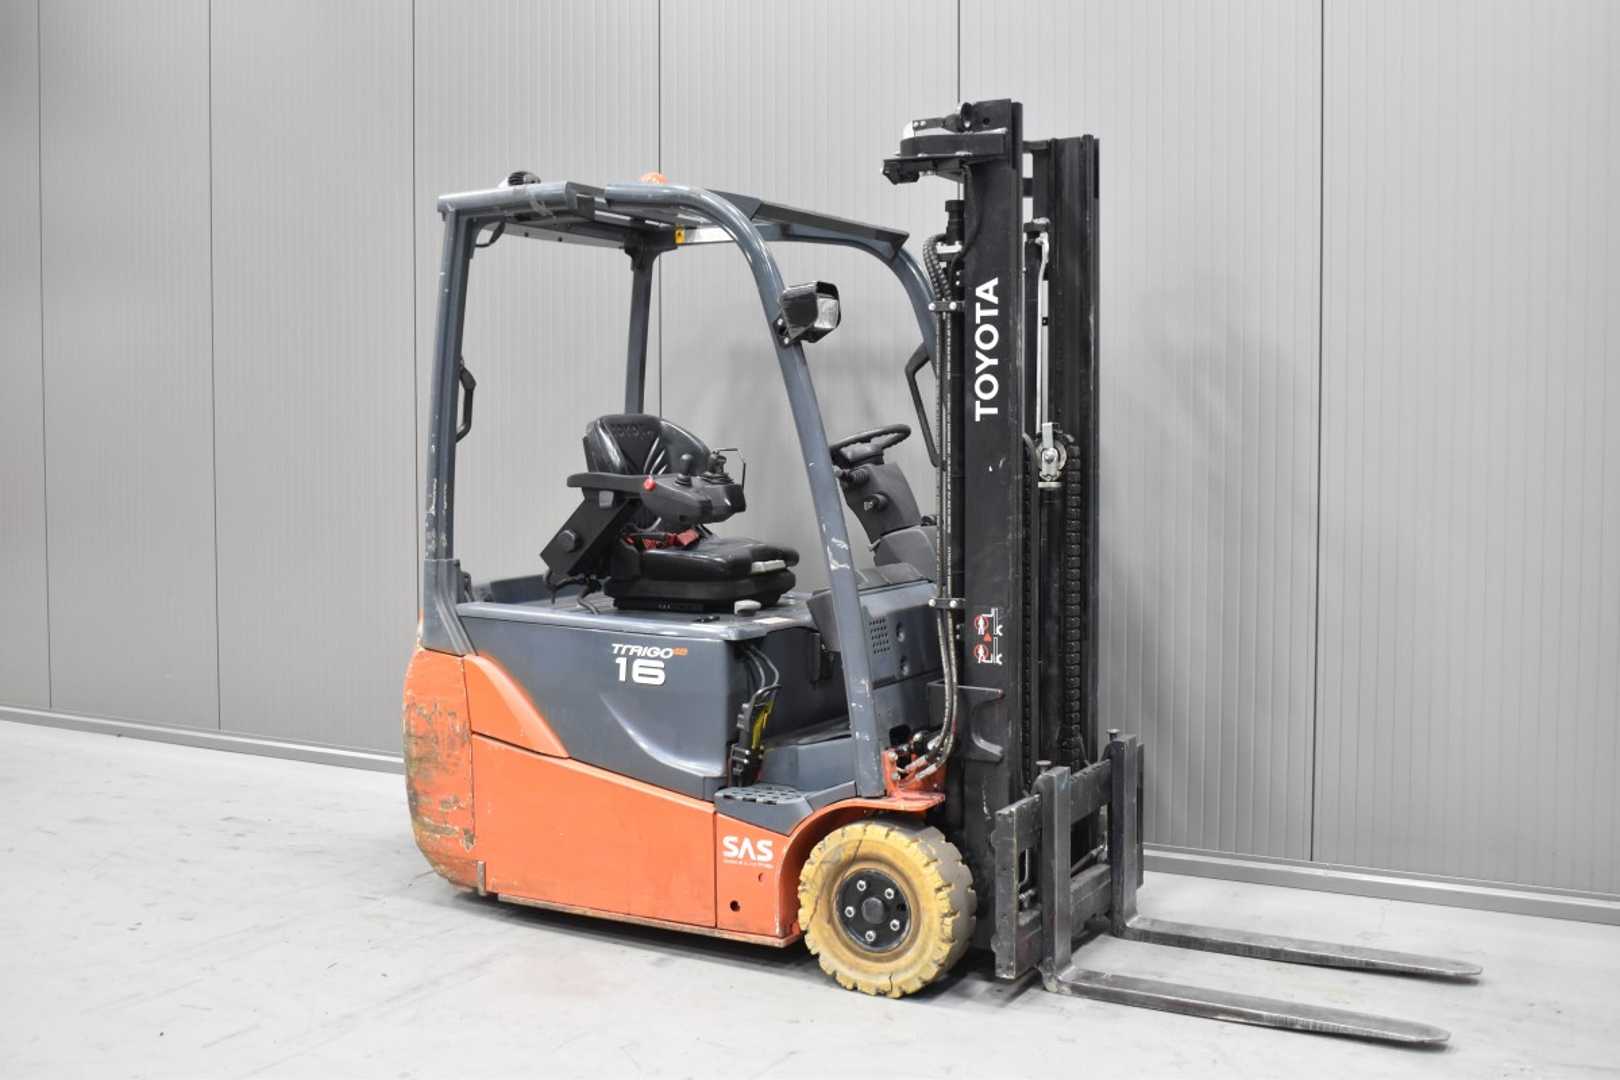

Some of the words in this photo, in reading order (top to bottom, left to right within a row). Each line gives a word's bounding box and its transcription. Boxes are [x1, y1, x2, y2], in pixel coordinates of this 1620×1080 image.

[974, 277, 1000, 422] TOYOTA
[615, 657, 666, 686] 16
[722, 835, 774, 863] SAS
